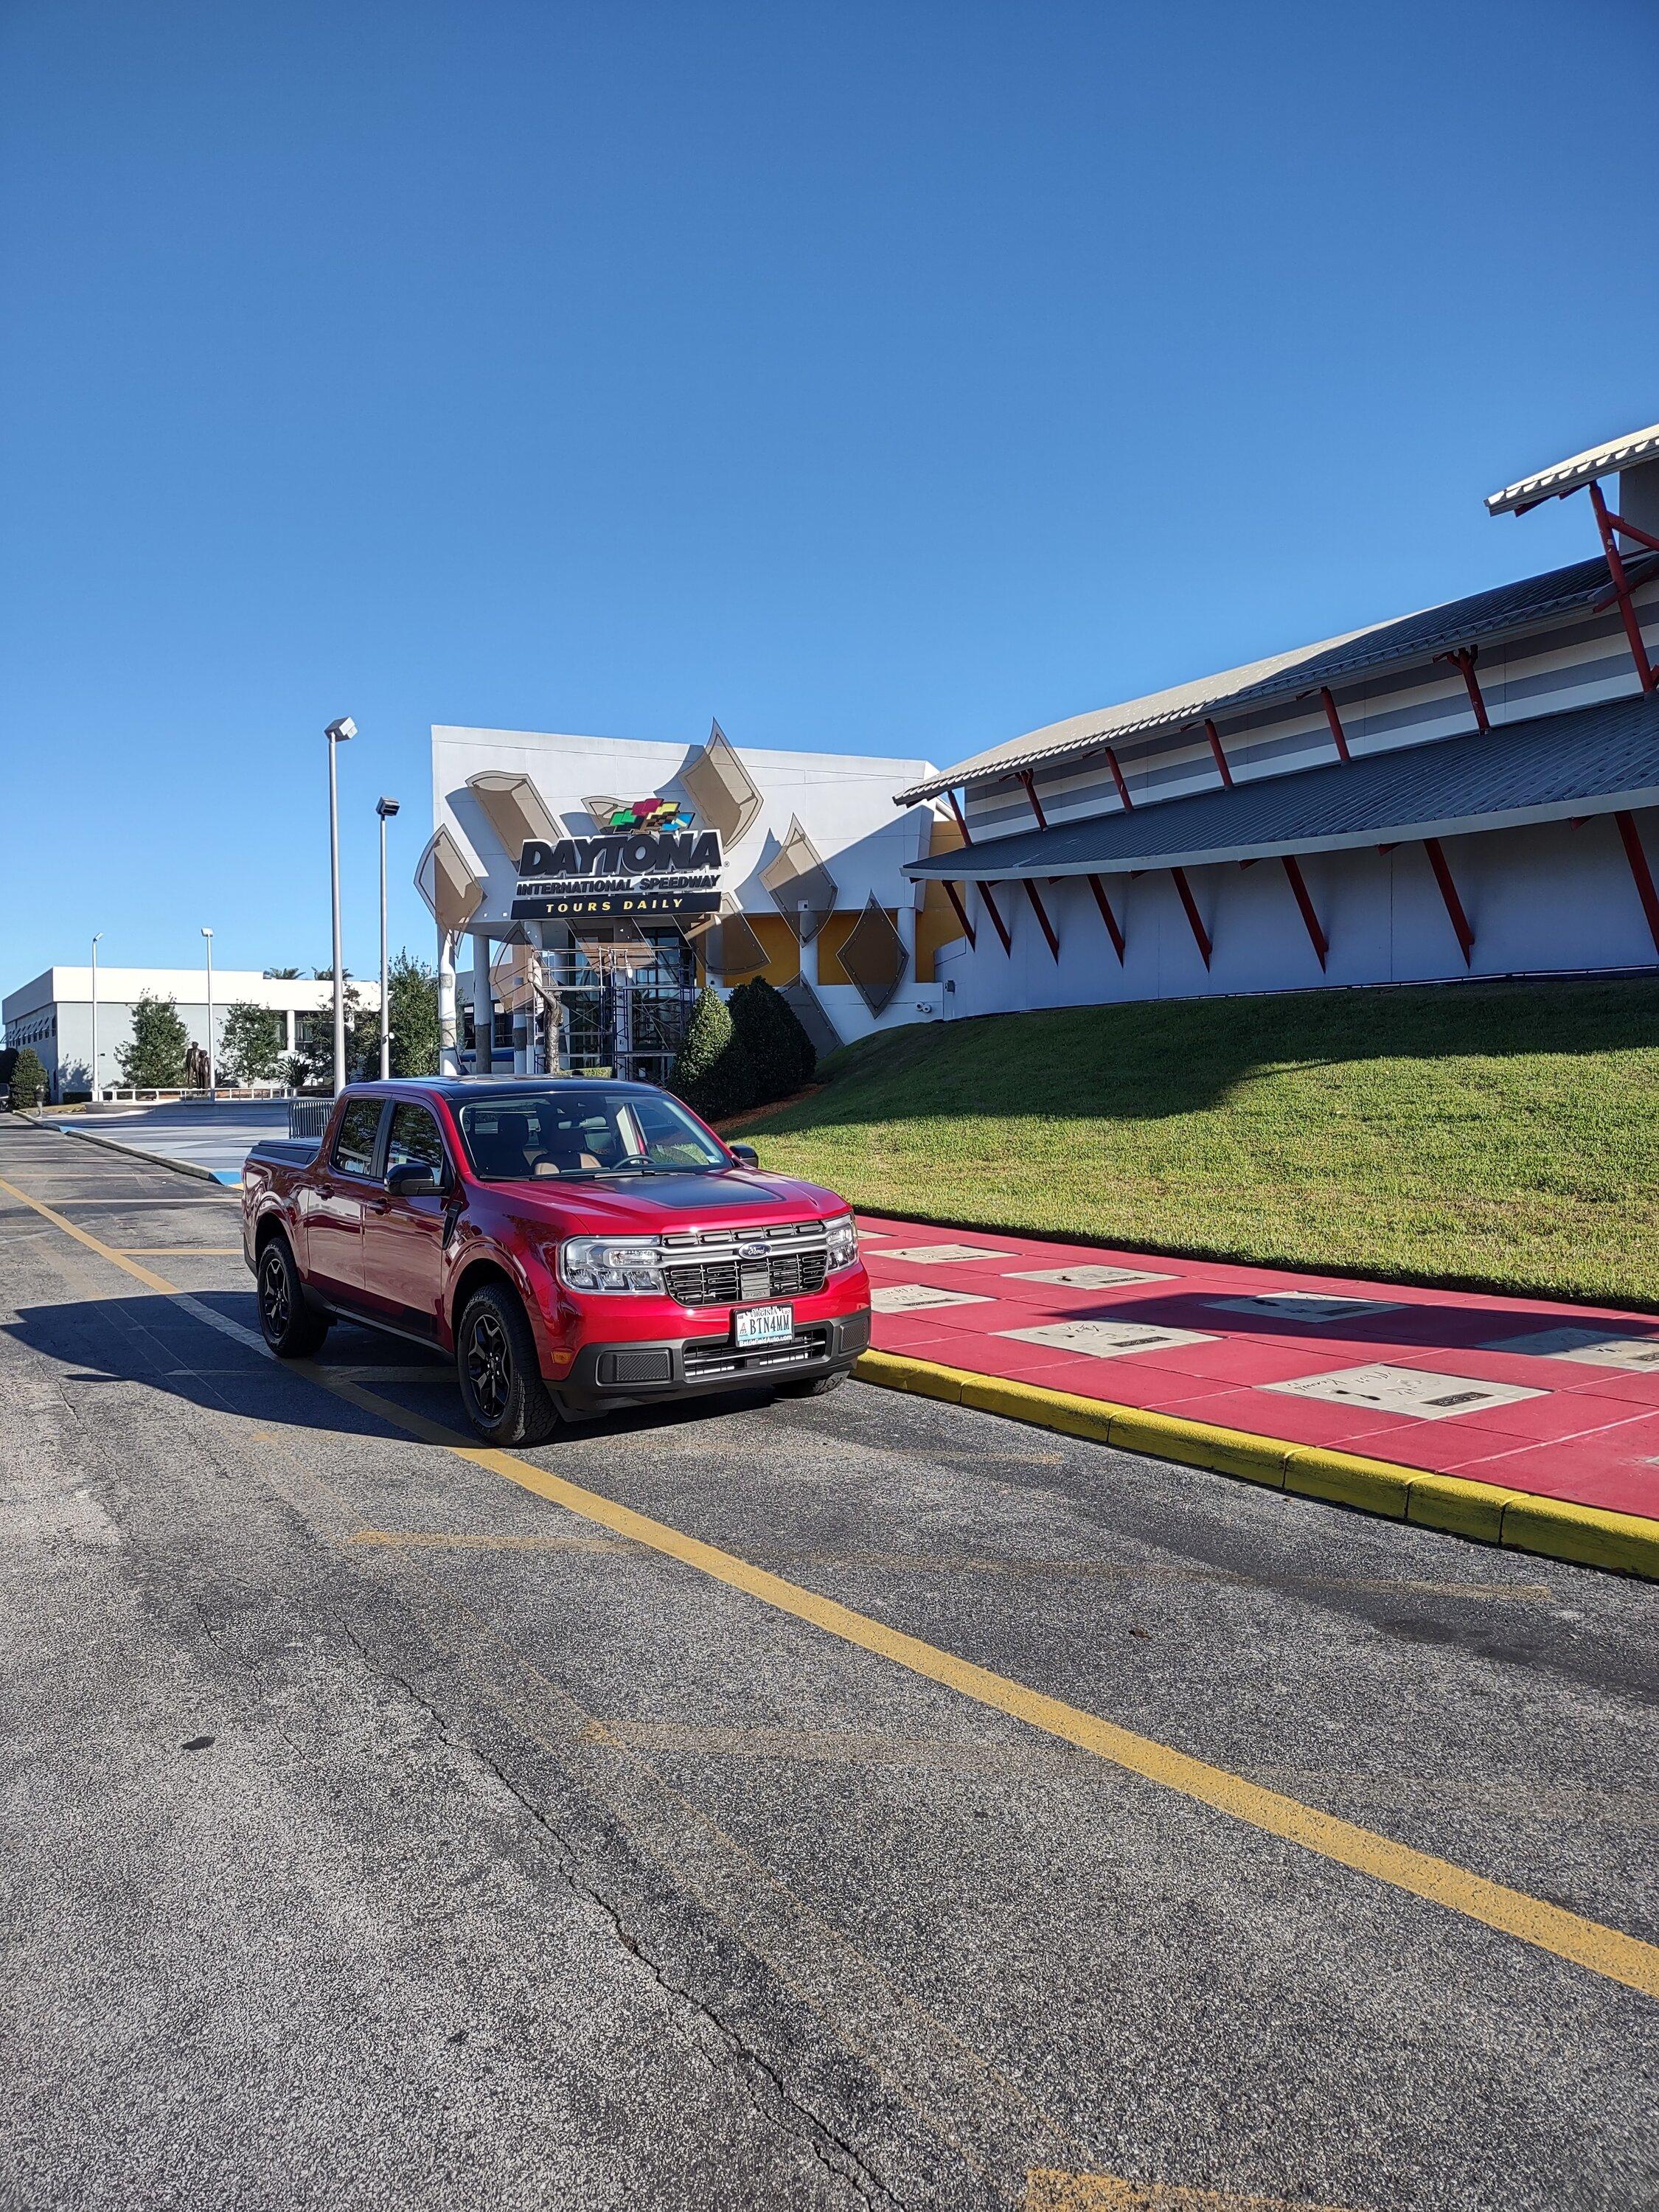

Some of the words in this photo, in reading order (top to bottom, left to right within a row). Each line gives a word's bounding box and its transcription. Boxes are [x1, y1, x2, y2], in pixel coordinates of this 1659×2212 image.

[519, 830, 722, 875] DAYTONA
[517, 880, 634, 895] INTERNATIONAL
[639, 874, 720, 891] SPEEDWAY
[546, 902, 611, 913] TOURS
[623, 899, 683, 910] DAILY
[748, 1246, 765, 1255] Ford
[751, 1308, 777, 1318] VIRGINIA
[750, 1315, 790, 1335] BTN4MM
